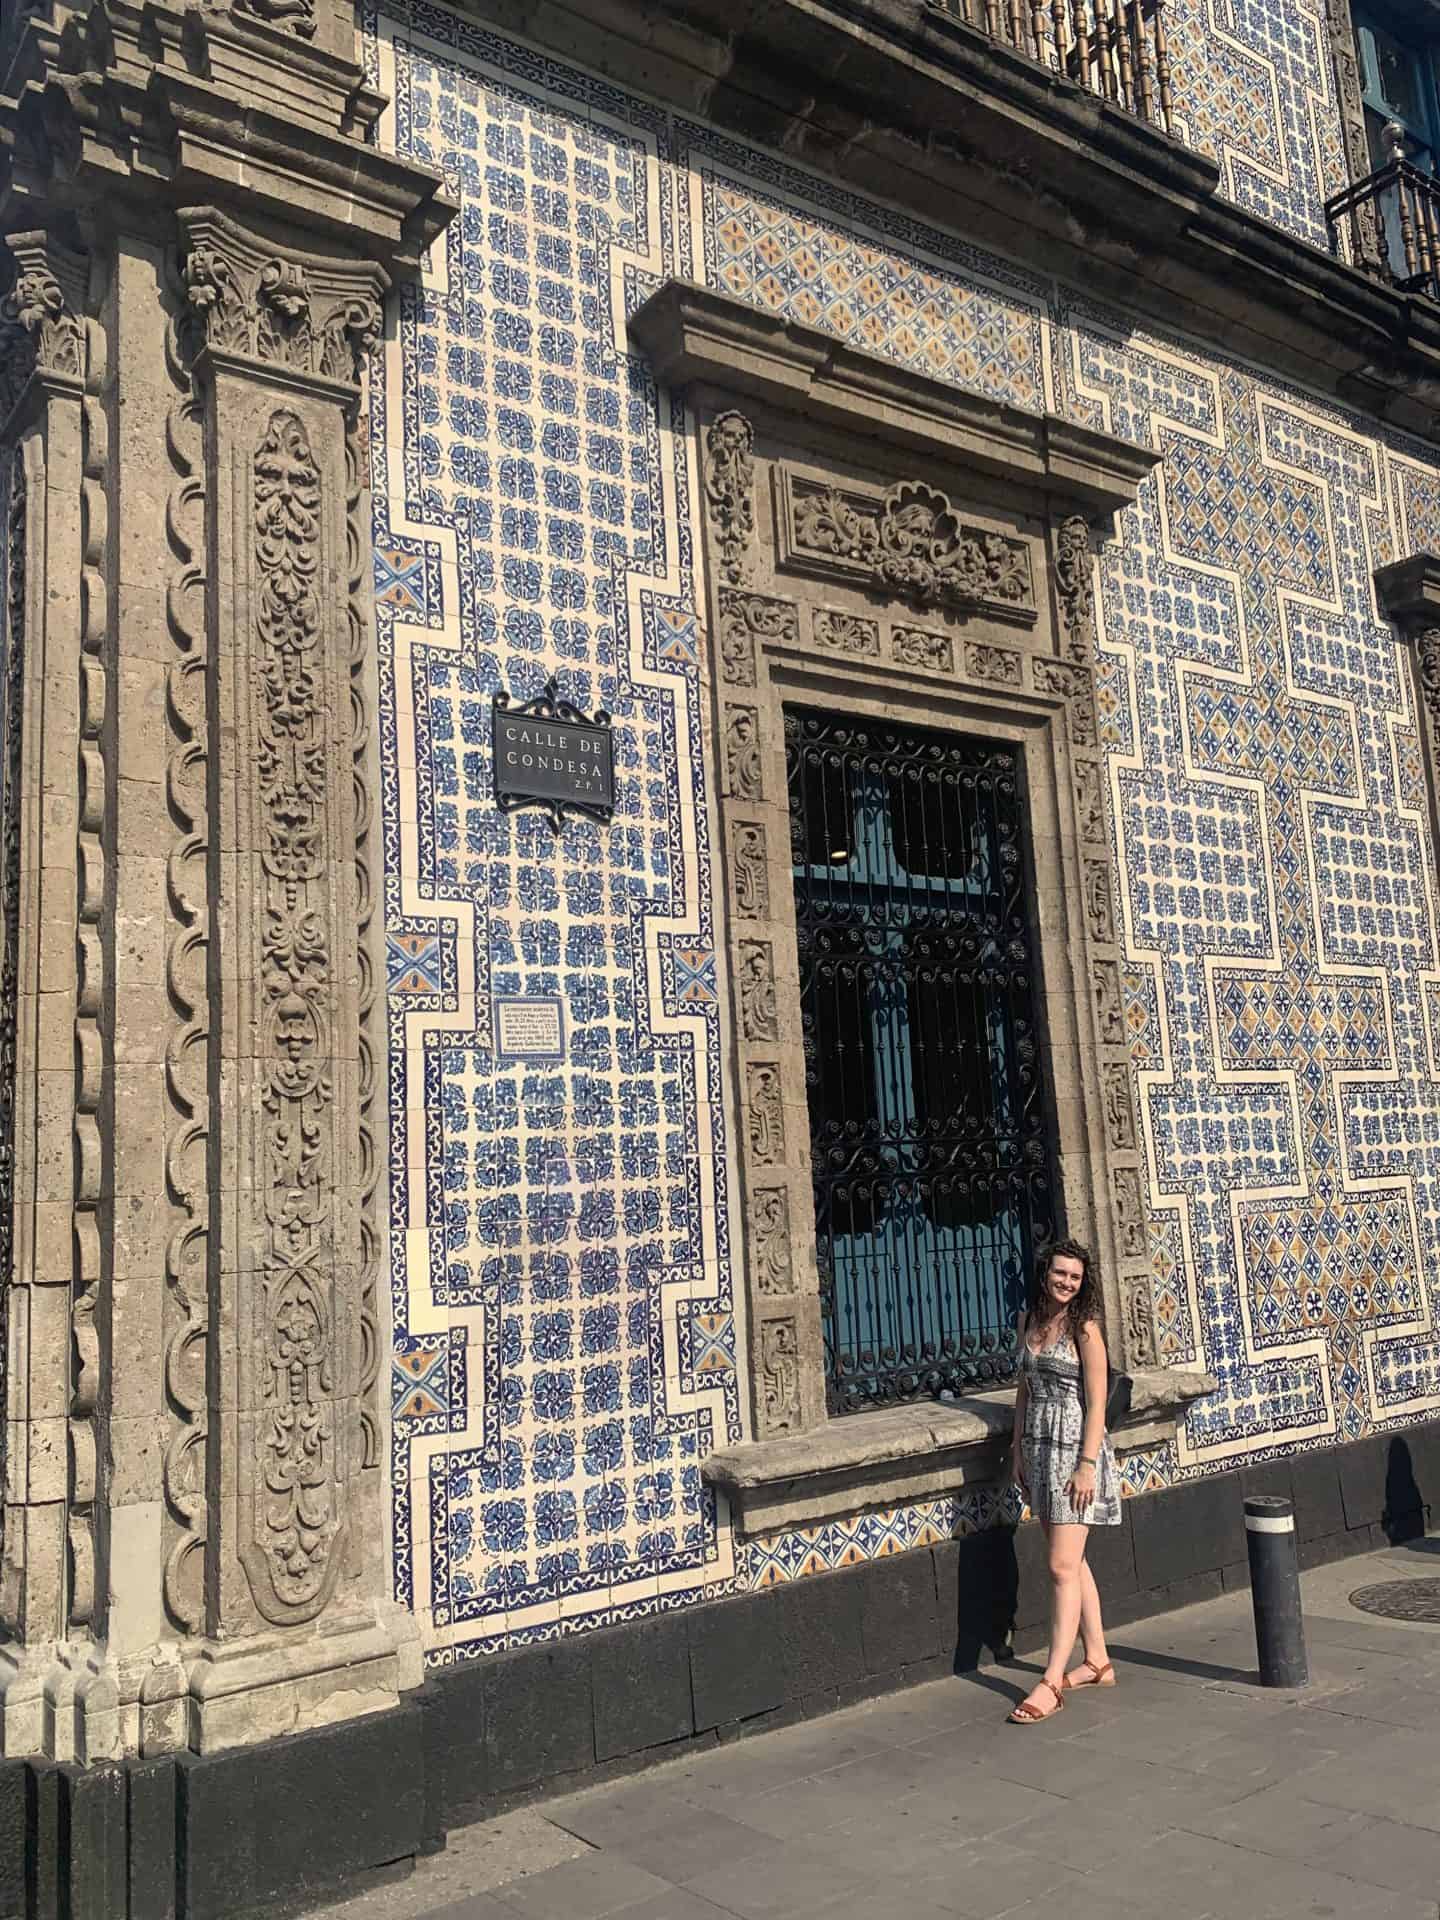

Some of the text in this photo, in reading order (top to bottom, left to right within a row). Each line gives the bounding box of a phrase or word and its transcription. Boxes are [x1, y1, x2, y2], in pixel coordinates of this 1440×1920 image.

[506, 728, 602, 754] CALLE DE
[506, 751, 602, 777] CONDESA
